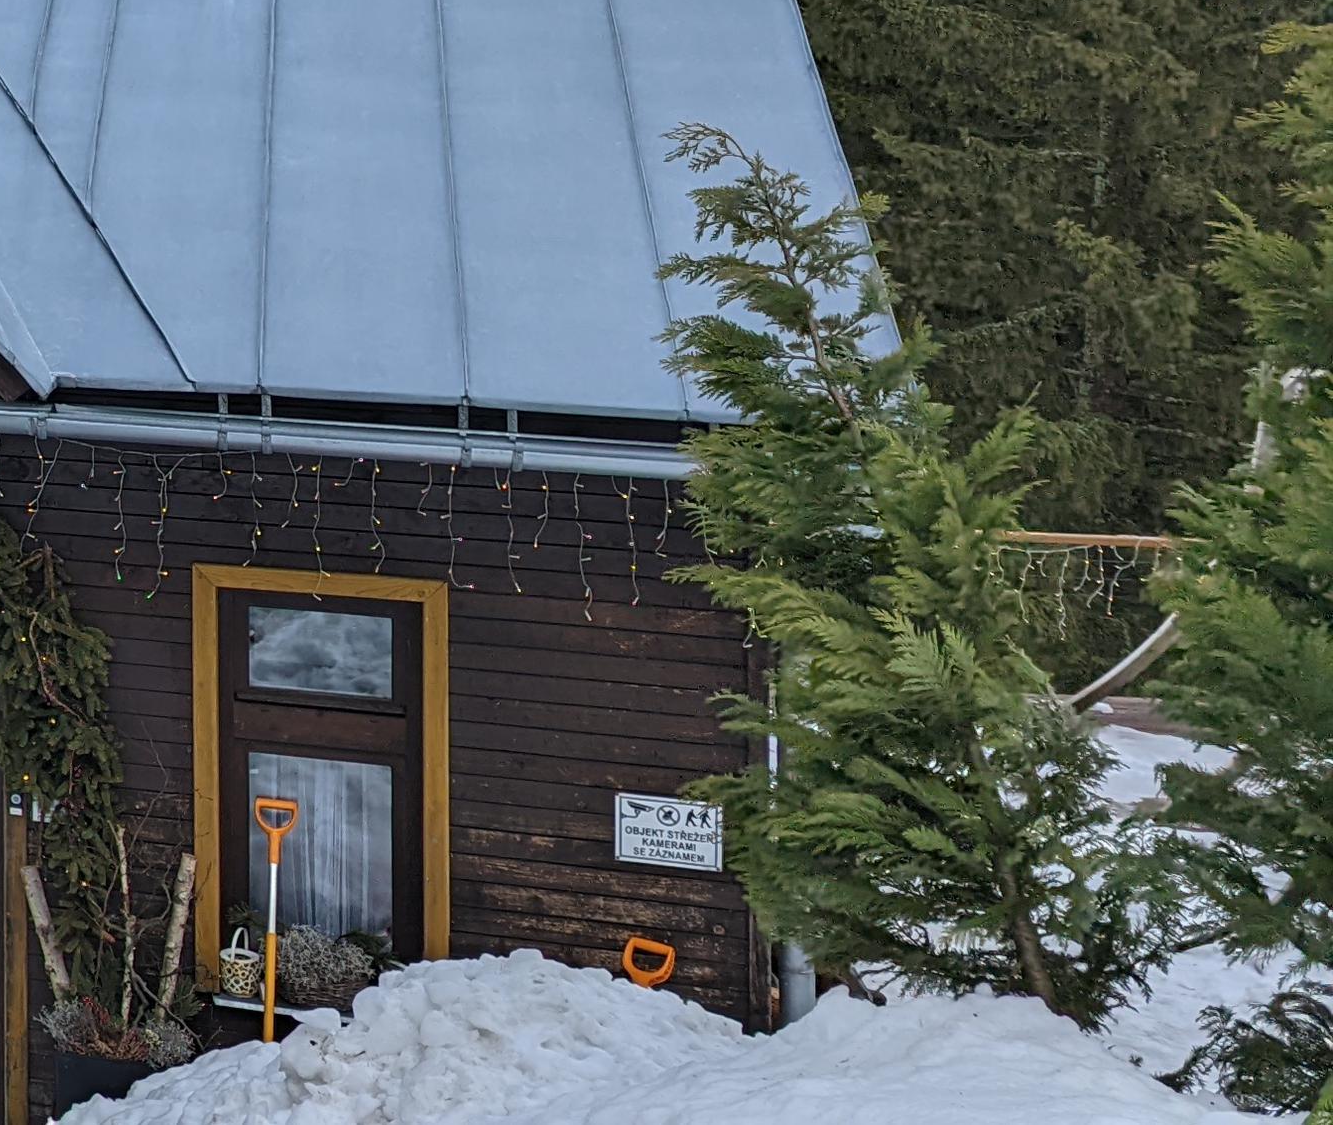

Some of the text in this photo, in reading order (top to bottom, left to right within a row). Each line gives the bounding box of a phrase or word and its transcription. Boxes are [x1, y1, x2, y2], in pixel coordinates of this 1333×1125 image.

[625, 825, 664, 838] OBJEKT
[642, 837, 697, 852] KAMERAMI
[633, 847, 705, 863] SE ZÁZNAMEM
